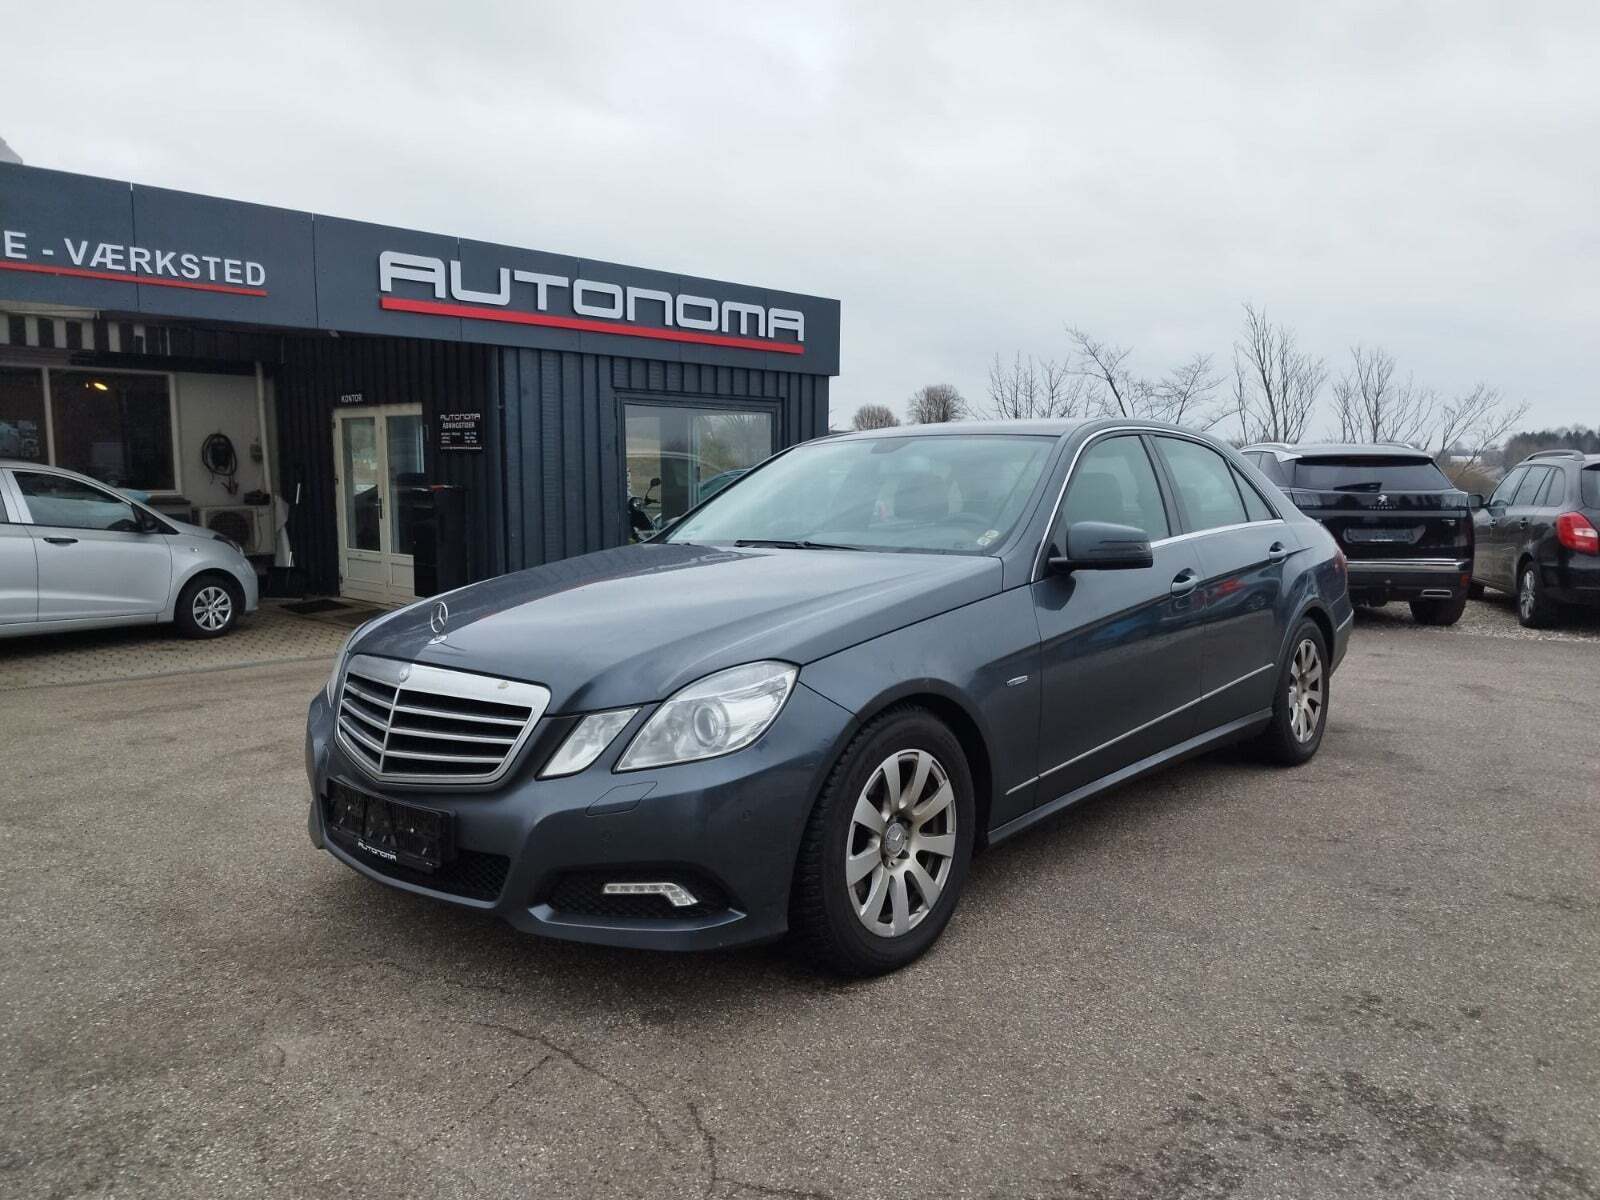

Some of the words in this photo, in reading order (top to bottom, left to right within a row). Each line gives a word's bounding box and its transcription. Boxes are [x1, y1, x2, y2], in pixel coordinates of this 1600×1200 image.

[4, 230, 28, 260] E
[63, 238, 267, 287] VÆRKSTED
[379, 250, 805, 342] AUTONOMA
